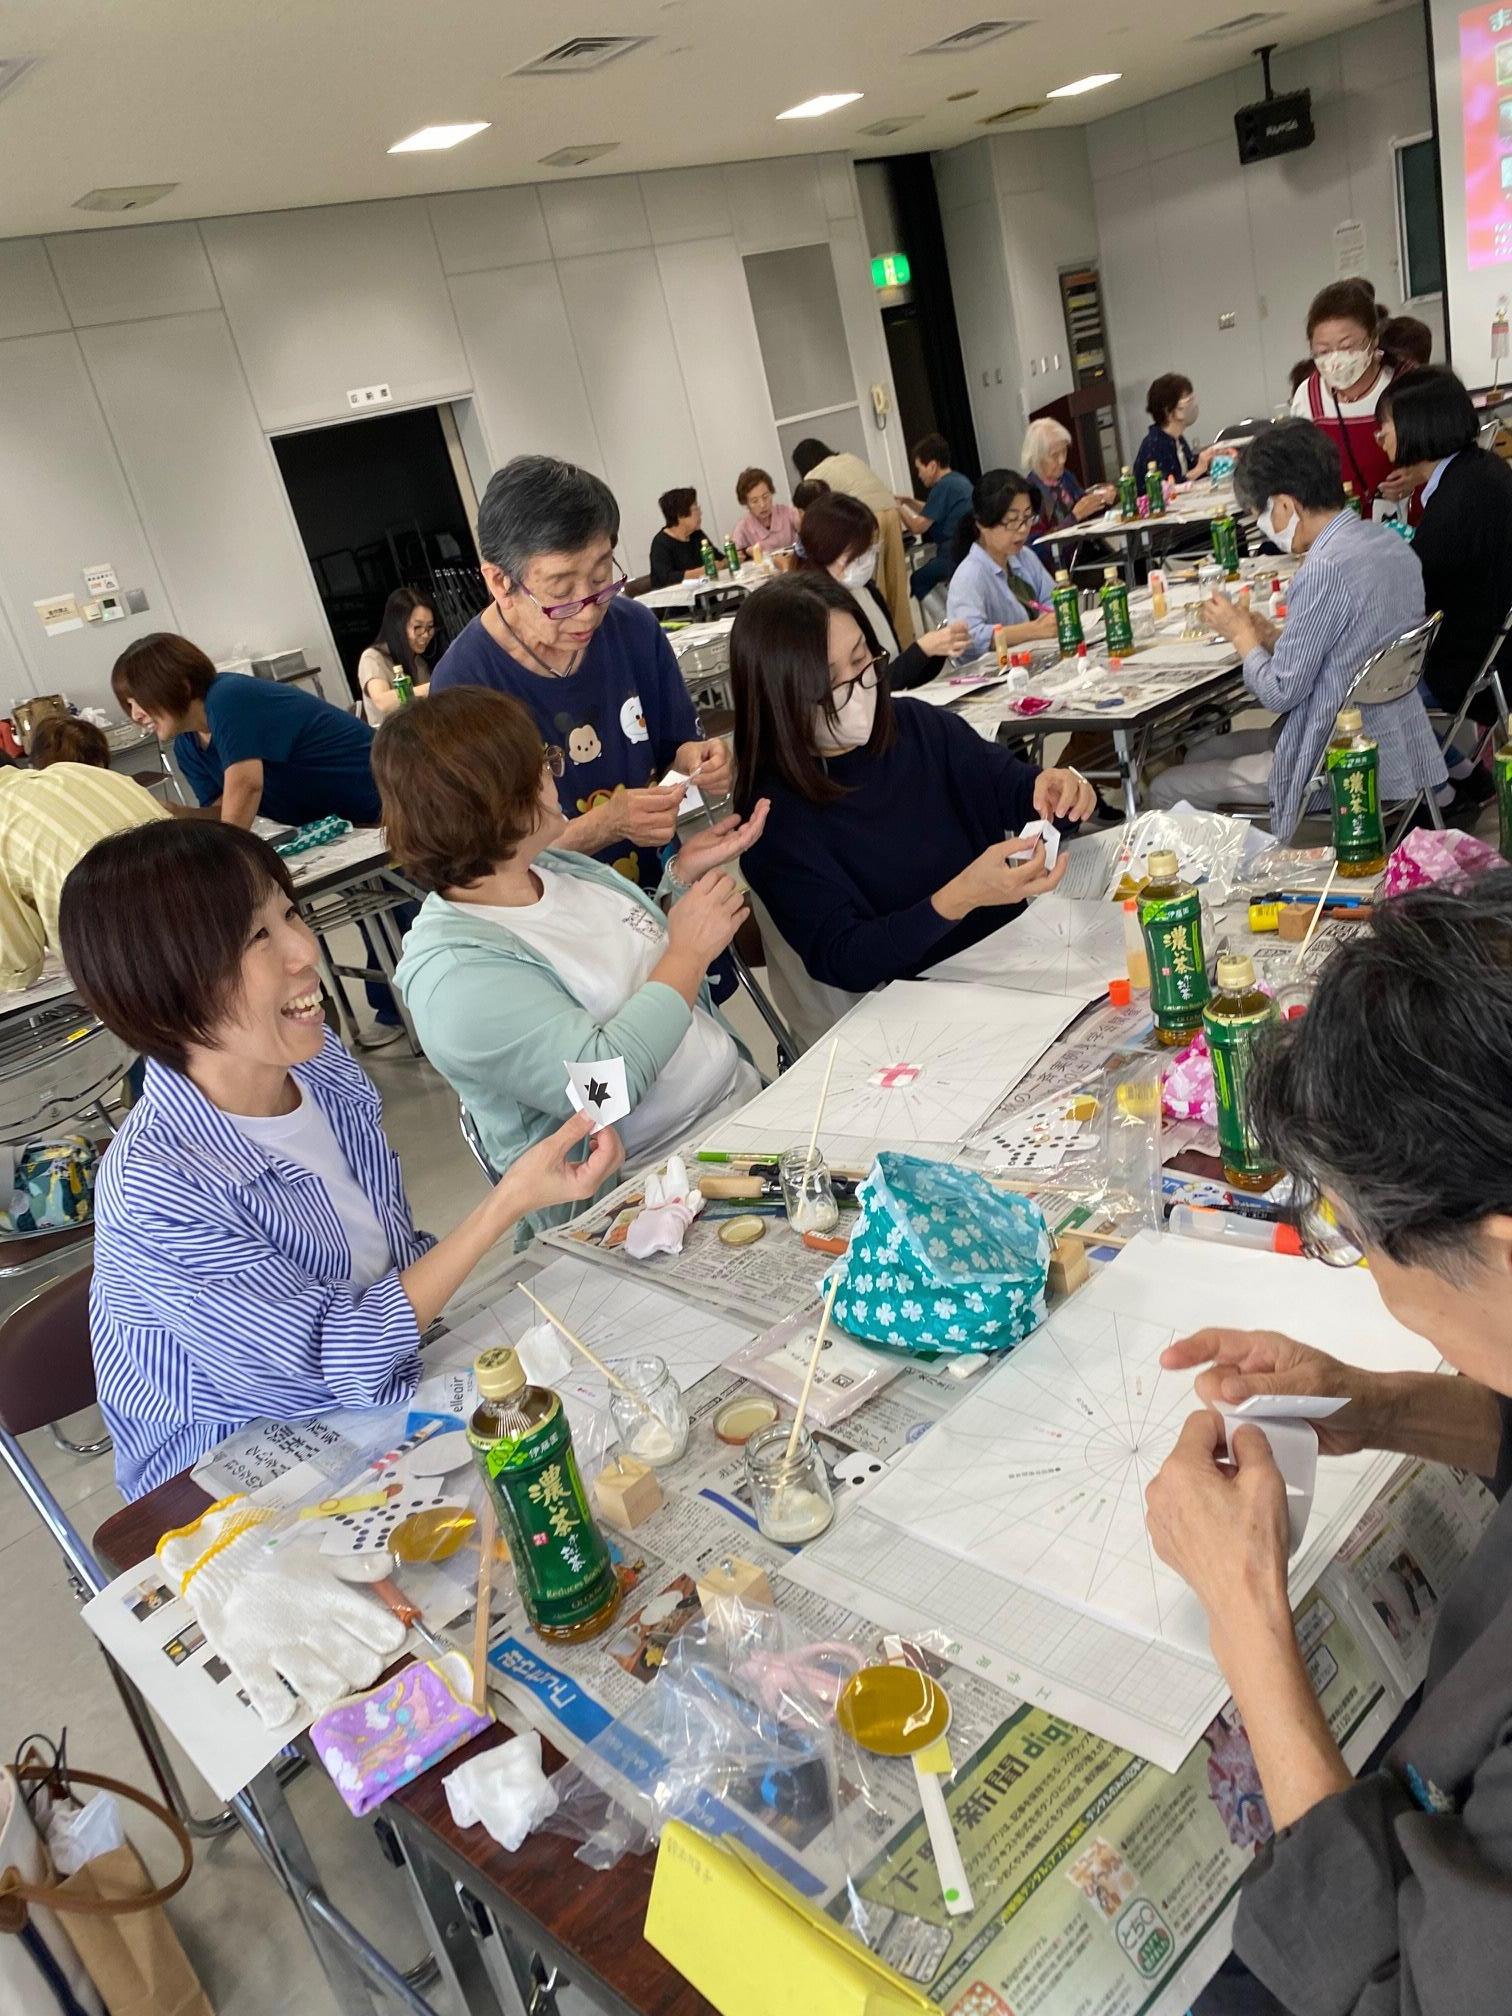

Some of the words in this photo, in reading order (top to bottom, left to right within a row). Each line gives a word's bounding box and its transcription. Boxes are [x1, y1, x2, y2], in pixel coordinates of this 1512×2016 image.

[449, 1376, 465, 1413] elleair
[528, 1431, 560, 1459] 伊藤園
[528, 1463, 581, 1537] 濃い茶
